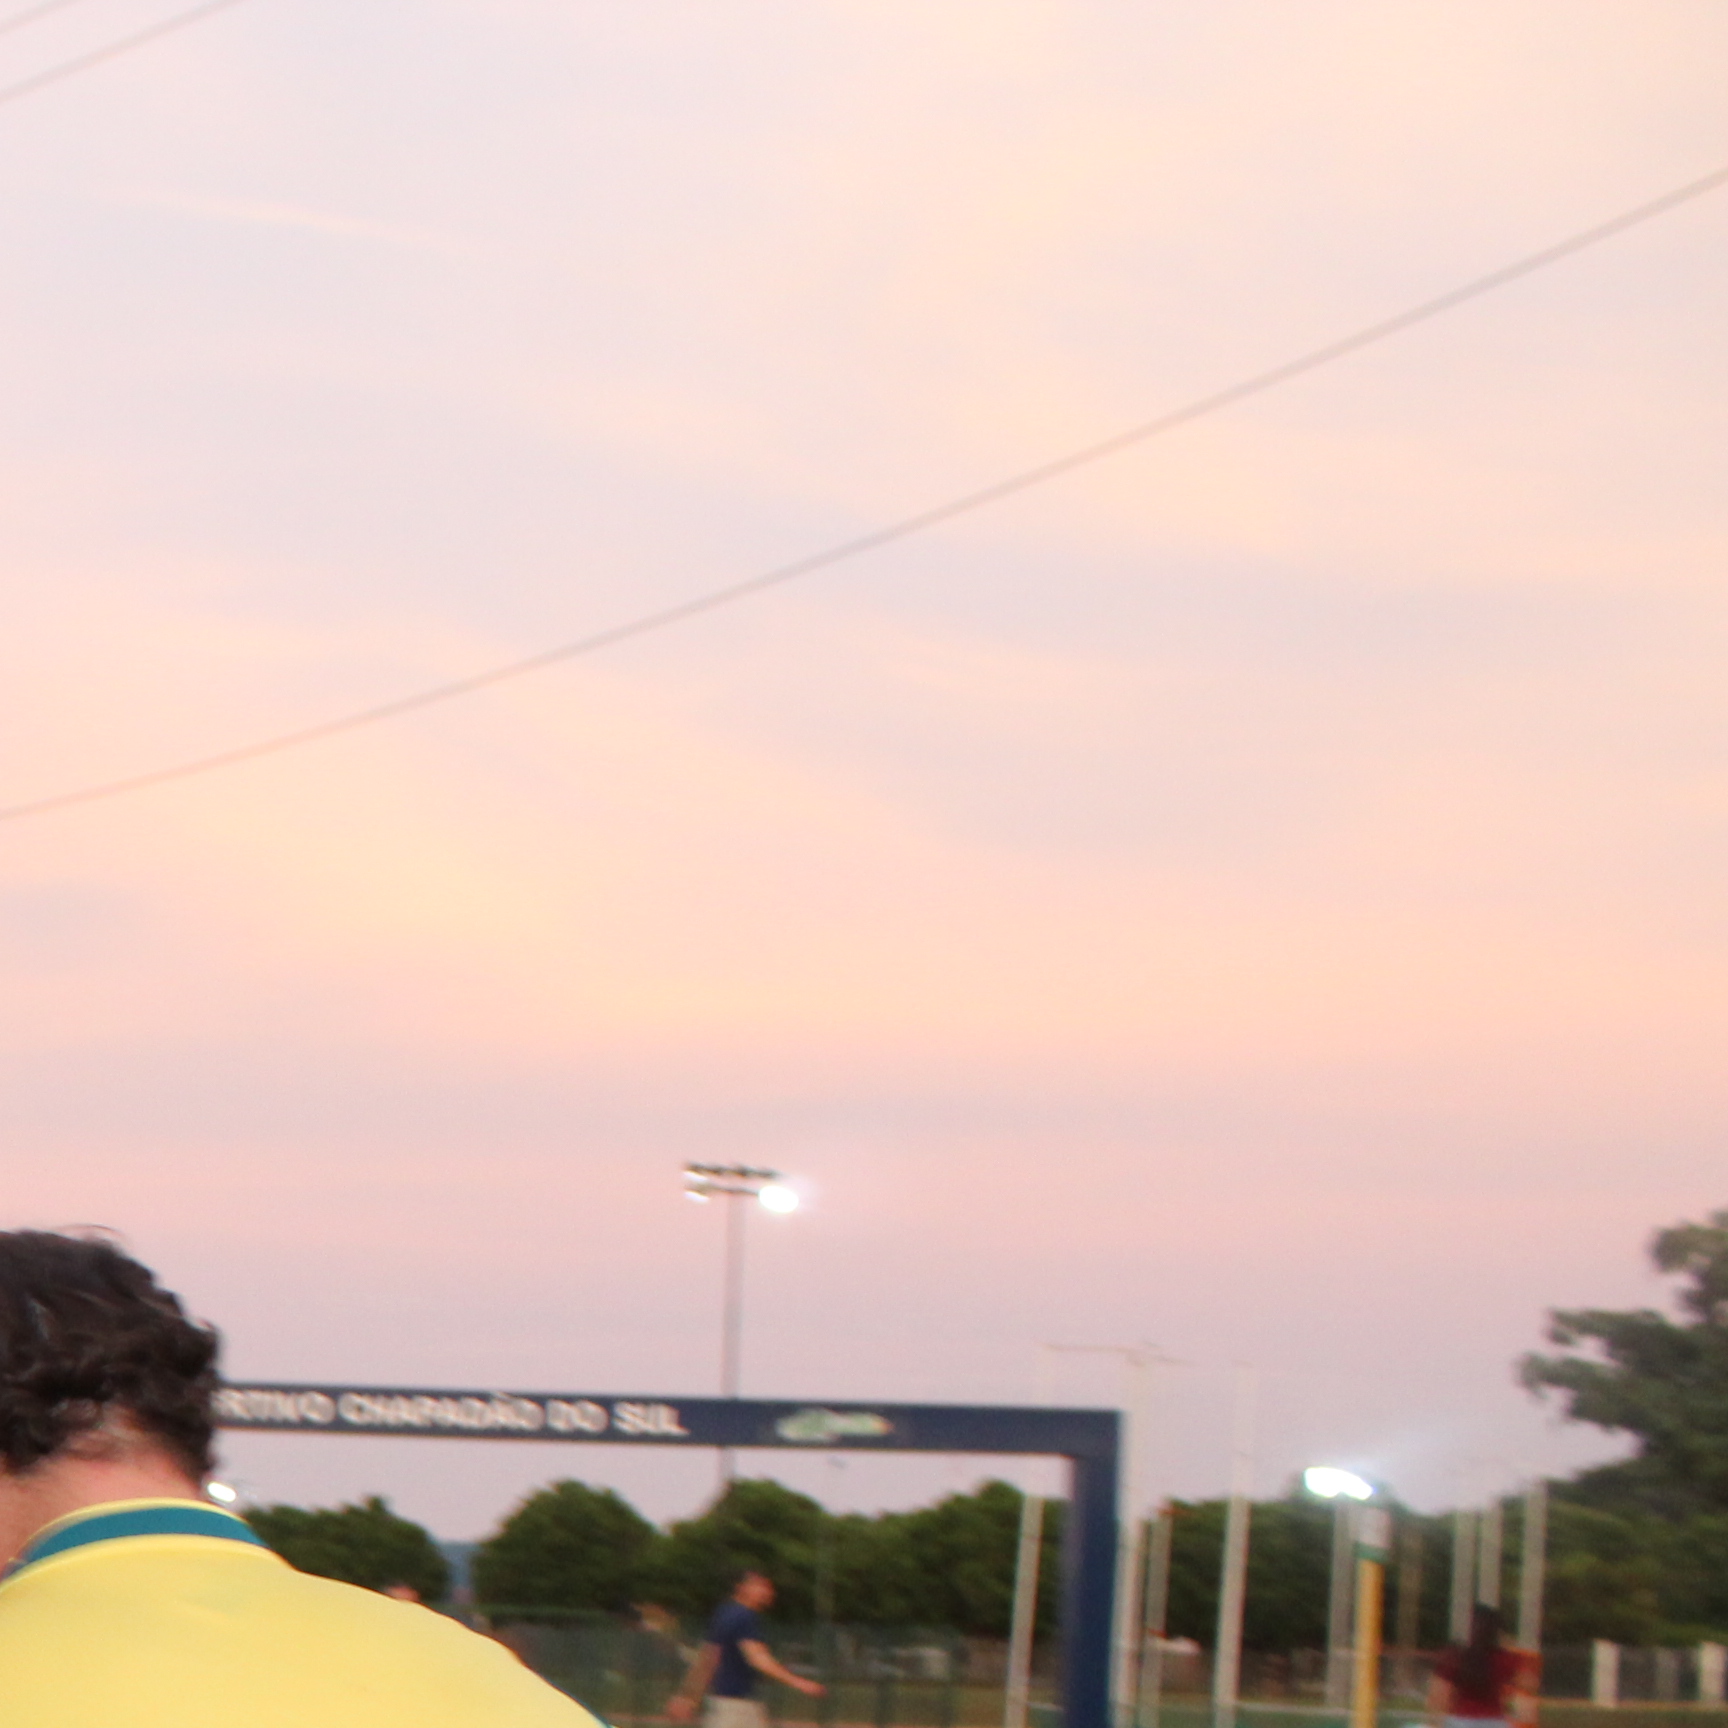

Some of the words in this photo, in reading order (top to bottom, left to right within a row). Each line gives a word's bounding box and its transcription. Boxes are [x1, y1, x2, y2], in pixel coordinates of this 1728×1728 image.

[209, 1387, 336, 1425] RTIVO
[546, 1399, 609, 1434] DO
[612, 1401, 691, 1436] SUL
